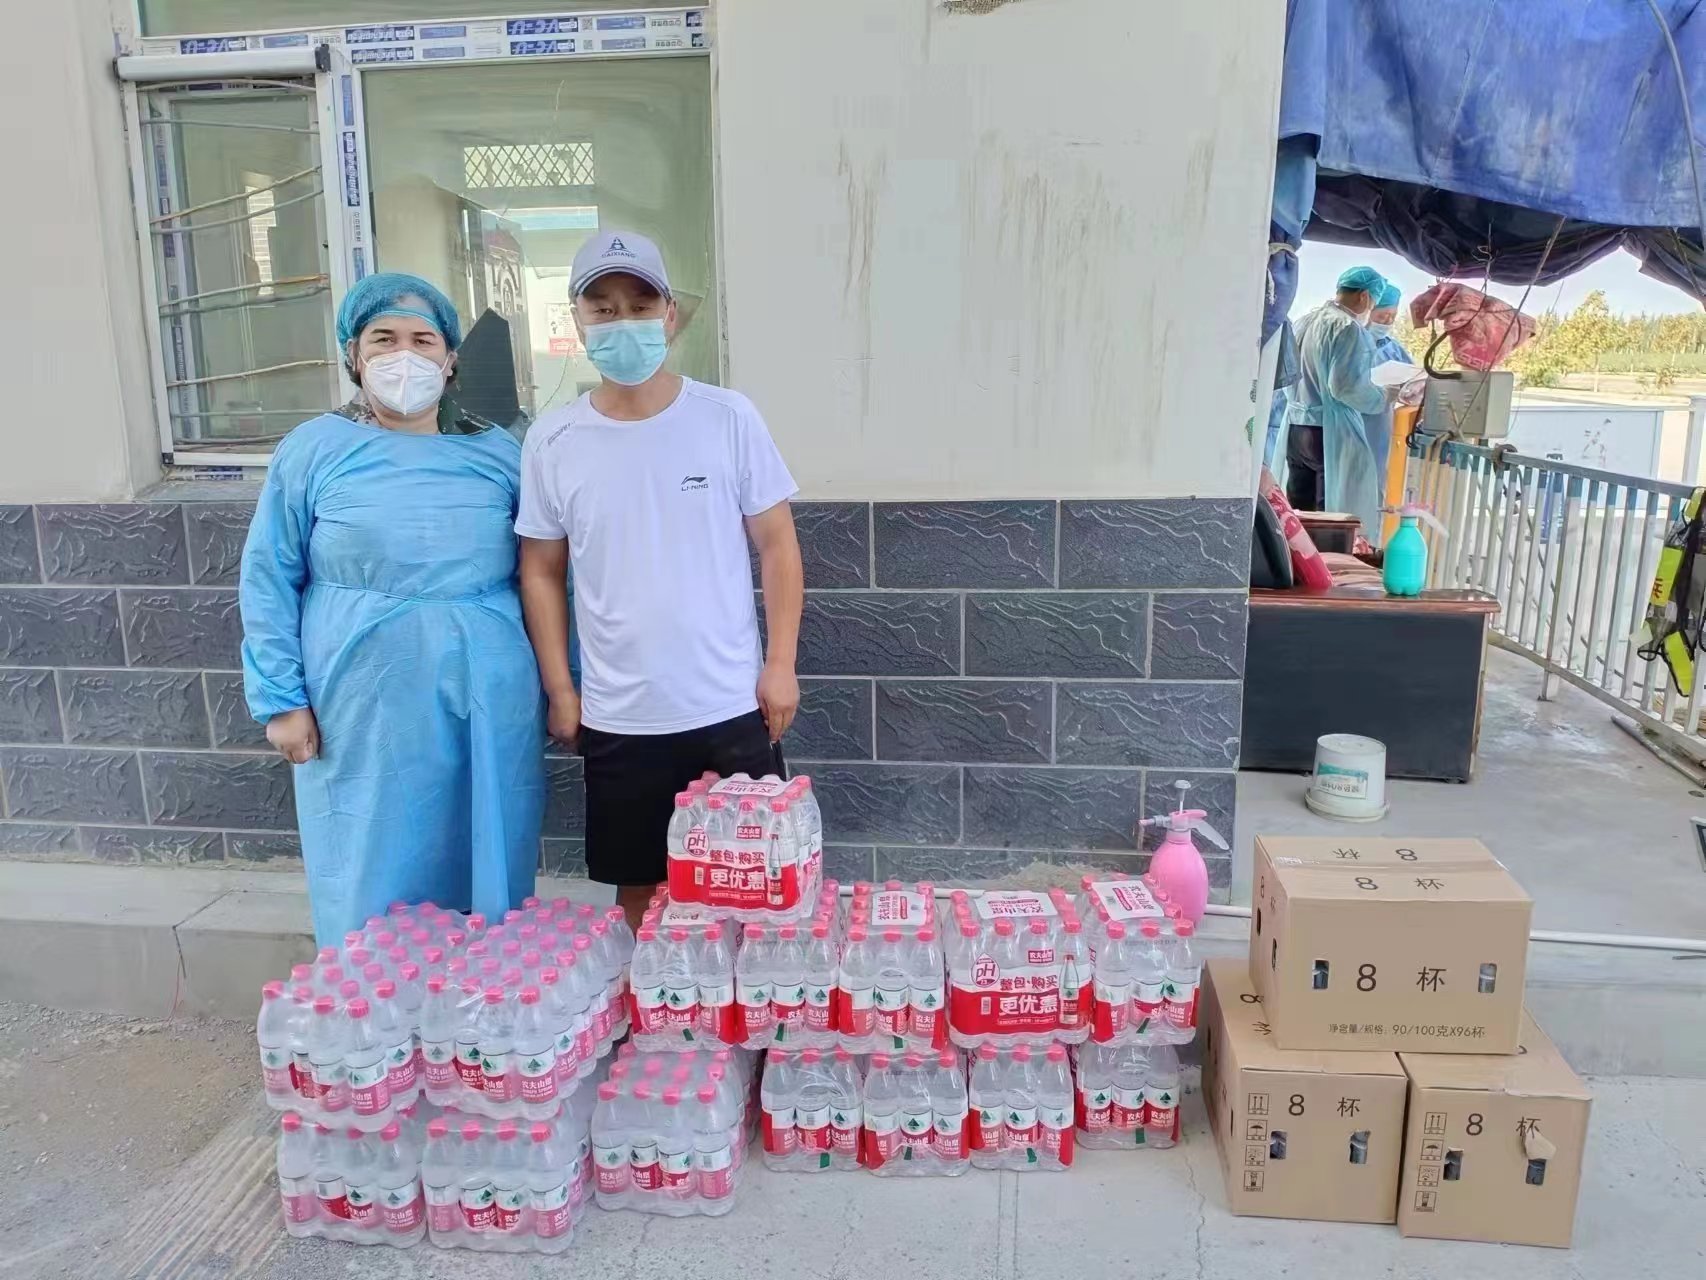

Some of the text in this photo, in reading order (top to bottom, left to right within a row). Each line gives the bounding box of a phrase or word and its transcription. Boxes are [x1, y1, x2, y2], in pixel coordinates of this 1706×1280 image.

[687, 833, 706, 850] pH
[1332, 848, 1418, 861] 8 杯
[709, 868, 766, 891] 更优惠
[1355, 877, 1444, 890] 8 杯
[976, 964, 996, 982] pH
[1356, 963, 1447, 992] 8 杯
[999, 994, 1058, 1016] 更优惠
[521, 1076, 553, 1089] 农夫山泉
[1288, 1094, 1361, 1118] 8 杯
[1466, 1113, 1541, 1139] 8 杯
